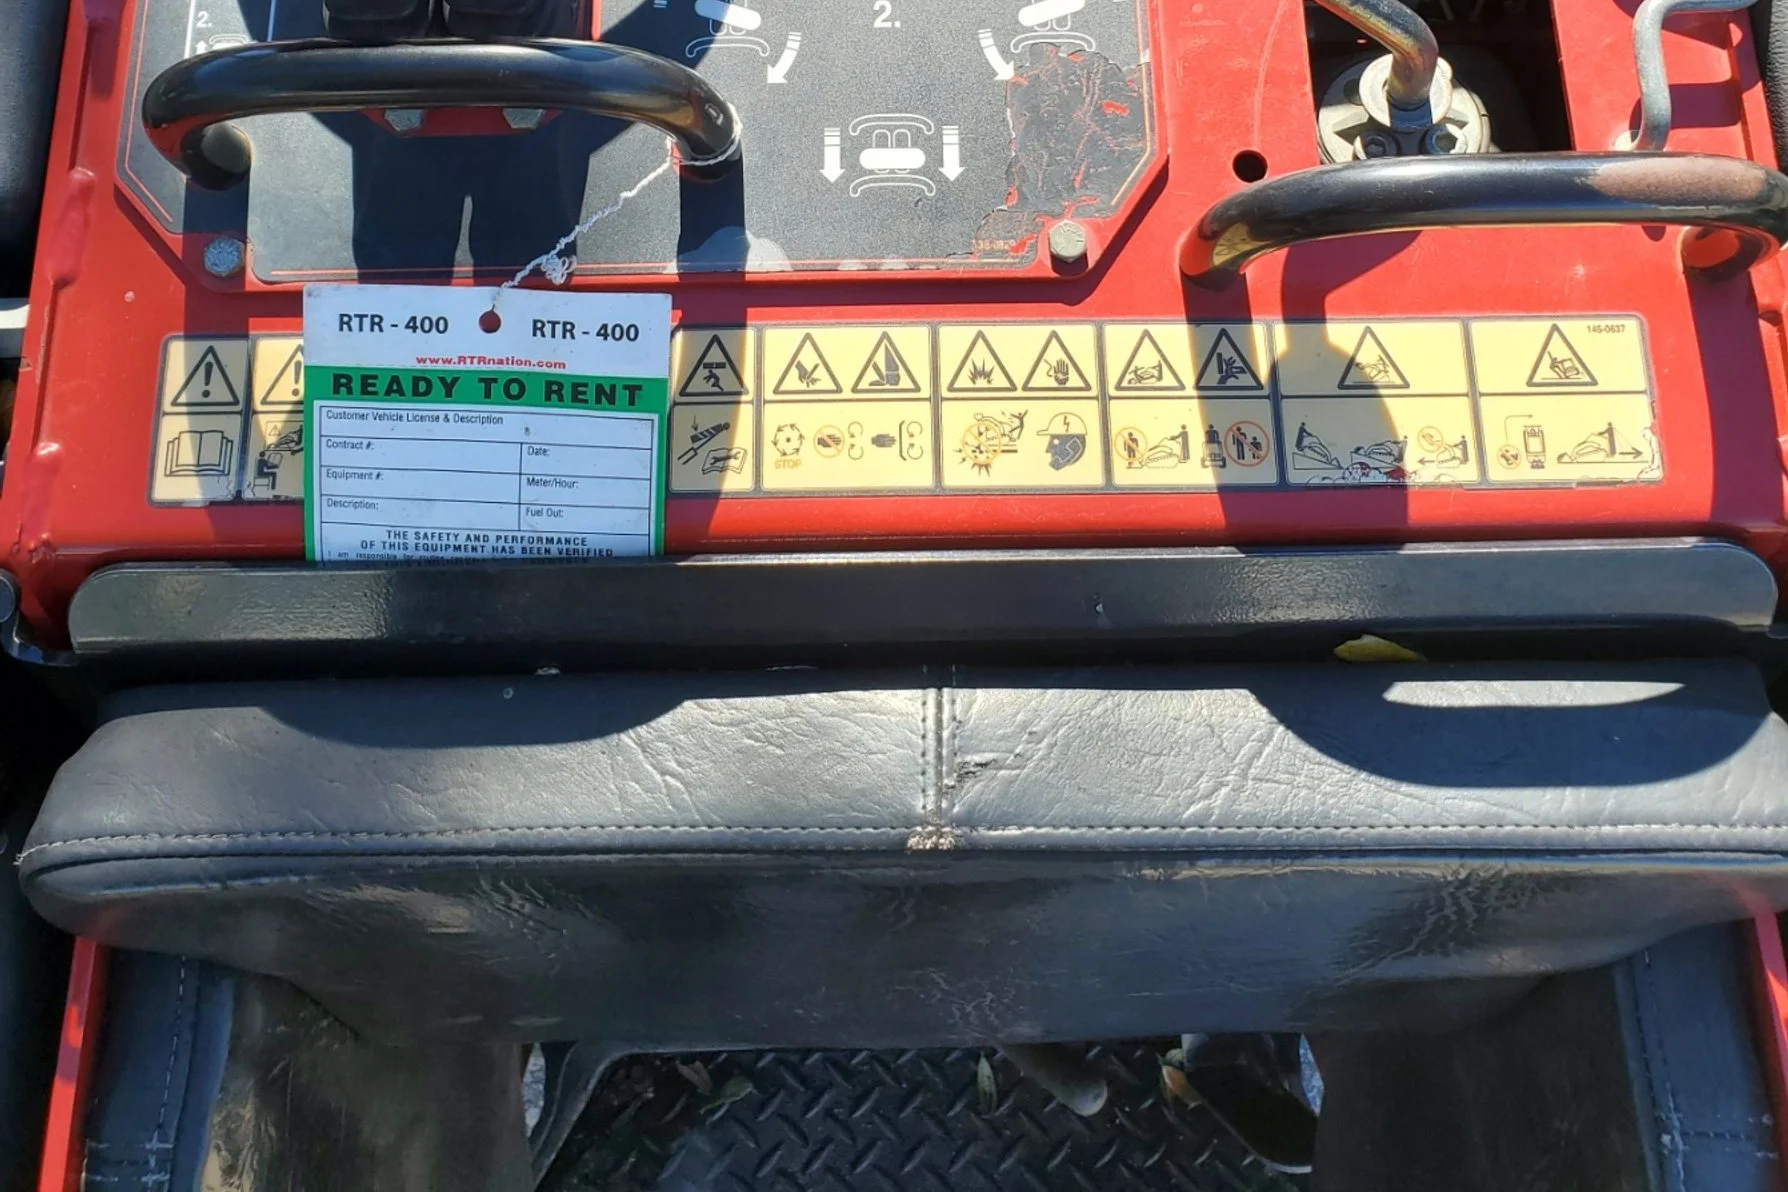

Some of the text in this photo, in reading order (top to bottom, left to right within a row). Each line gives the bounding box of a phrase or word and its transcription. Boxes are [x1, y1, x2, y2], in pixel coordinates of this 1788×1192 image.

[196, 10, 213, 27] 2.
[873, 1, 901, 28] 2.
[338, 313, 385, 333] RTR
[404, 315, 449, 335] 400
[532, 319, 576, 340] RTR
[595, 323, 640, 342] 400
[415, 355, 567, 370] www.RTRnation.com
[332, 373, 643, 406] READY TO RENT
[326, 410, 504, 425] Customer Vehicle License & Description
[326, 439, 363, 450] Contract
[527, 446, 550, 457] Date:
[774, 459, 802, 469] STOP
[326, 469, 373, 481] Equipment
[526, 477, 579, 489] Meter/Hour:
[326, 498, 379, 511] Description:
[525, 508, 564, 518] Fuel Out:
[387, 530, 588, 546] THE SAFETY AND PERFORMANCE
[361, 540, 614, 557] OF THIS EQUIPMENT HAS BEEN VERIFIED
